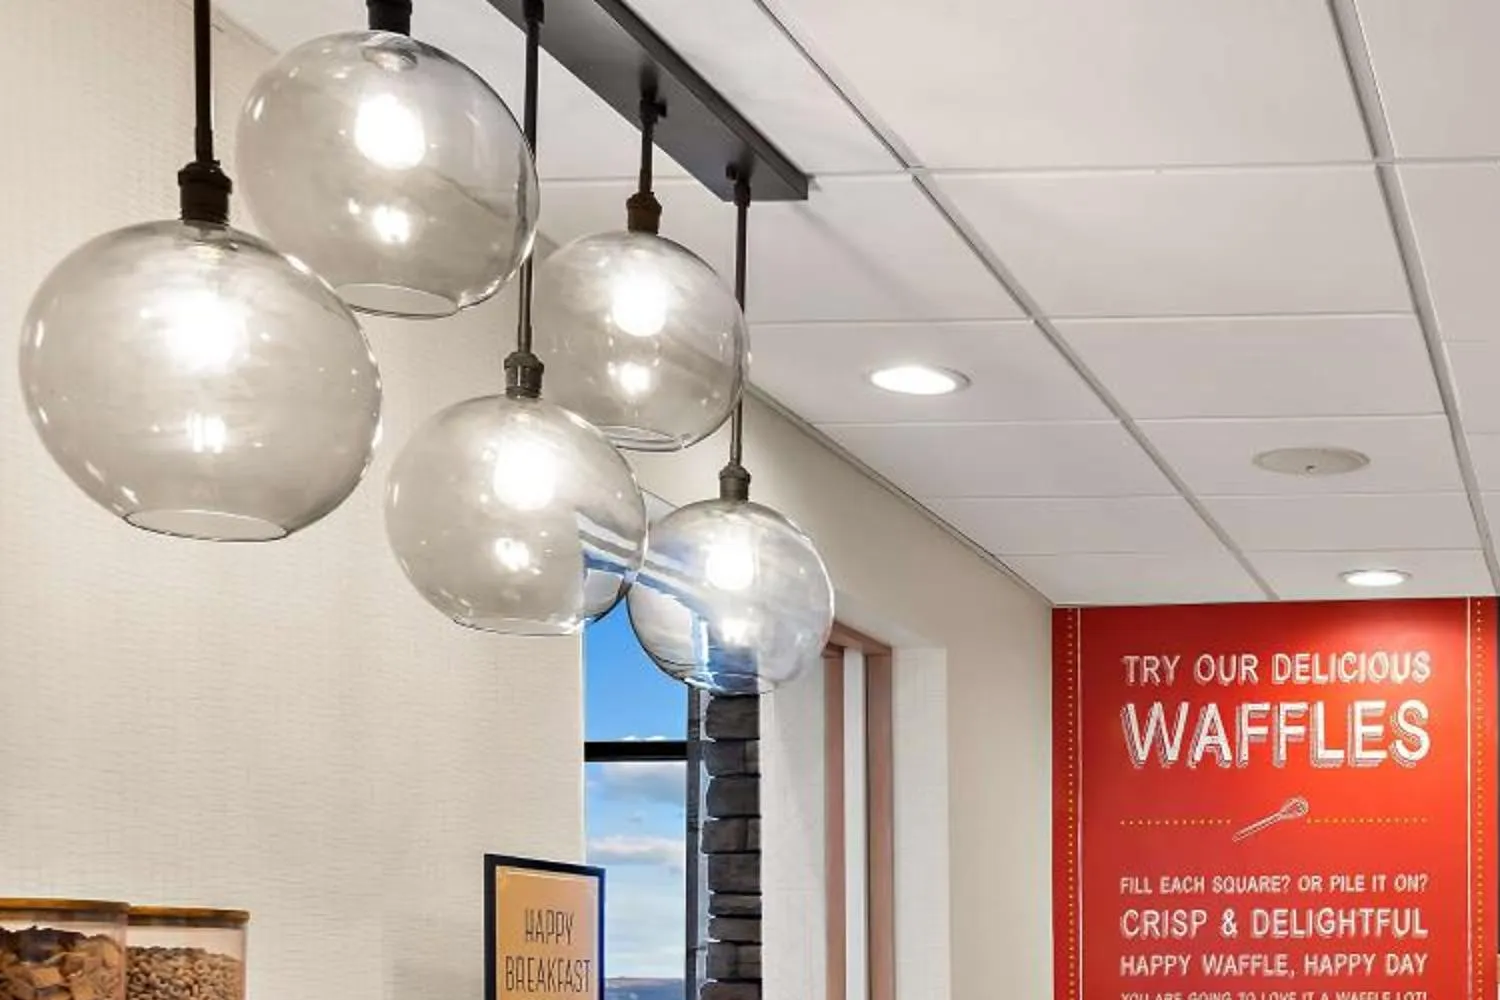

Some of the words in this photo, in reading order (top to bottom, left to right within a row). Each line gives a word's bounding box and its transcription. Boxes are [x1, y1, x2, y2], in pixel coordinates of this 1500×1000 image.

[1120, 654, 1181, 686] TRY
[1194, 653, 1259, 686] OUR
[1272, 651, 1431, 685] DELICIOUS
[1120, 699, 1431, 769] WAFFLES
[1120, 876, 1153, 895] FILL
[1159, 875, 1205, 894] EACH
[1211, 874, 1291, 894] SQUARE?
[1298, 874, 1323, 893] OR
[1330, 873, 1366, 893] PILE
[1372, 873, 1387, 893] IT
[1394, 873, 1429, 893] ON?
[524, 908, 575, 946] HAPPY
[1120, 908, 1208, 940] CRISP
[1221, 907, 1238, 938] &
[1252, 907, 1429, 939] DELIGHTFUL
[504, 955, 591, 993] BREAKFAST
[1120, 954, 1192, 977] HAPPY
[1202, 953, 1296, 979] WAFFLE,
[1303, 952, 1377, 977] HAPPY
[1385, 952, 1429, 977] DAY
